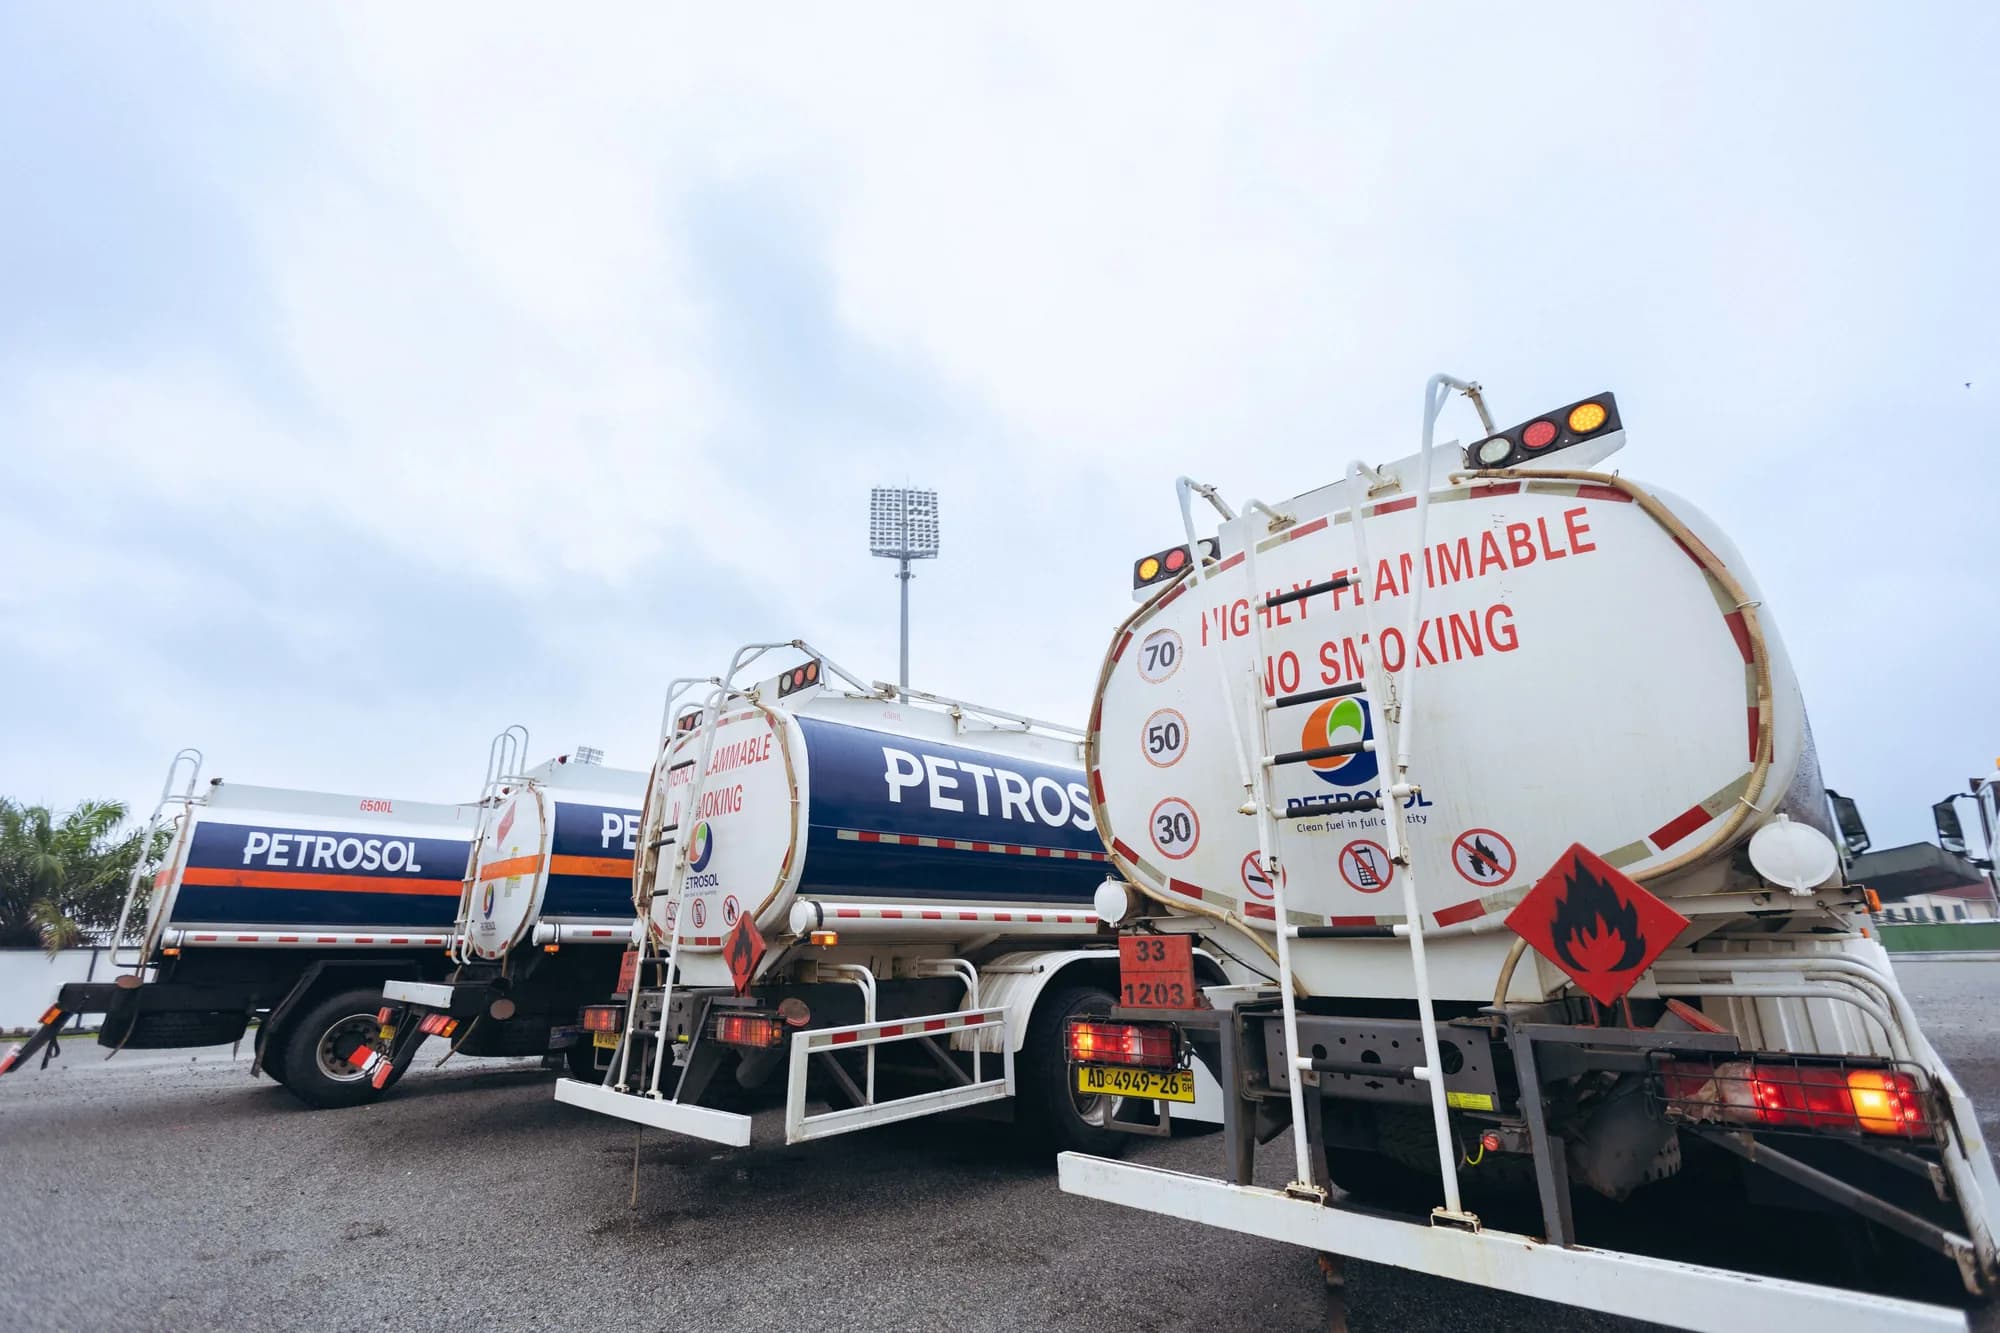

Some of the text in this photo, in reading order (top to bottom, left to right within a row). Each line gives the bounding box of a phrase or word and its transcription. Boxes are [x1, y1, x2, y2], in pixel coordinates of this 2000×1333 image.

[1332, 506, 1597, 611] FLAMMABLE
[1144, 640, 1175, 673] 70
[1319, 603, 1520, 686] SMOKING
[1148, 721, 1182, 754] 50
[704, 733, 772, 776] AMMABLE
[360, 799, 393, 814] 6500L
[695, 784, 743, 821] MOKING
[1156, 811, 1192, 846] 30
[1296, 821, 1324, 833] Clean
[1326, 820, 1345, 832] fuel
[1347, 819, 1358, 829] in
[1360, 817, 1378, 830] full
[242, 830, 422, 874] PETROSOL
[685, 873, 720, 890] ETROSOL
[1135, 939, 1166, 963] 33
[1123, 982, 1185, 1007] 1203
[1087, 1070, 1180, 1096] AD 4949-26
[1182, 1082, 1193, 1094] GH
